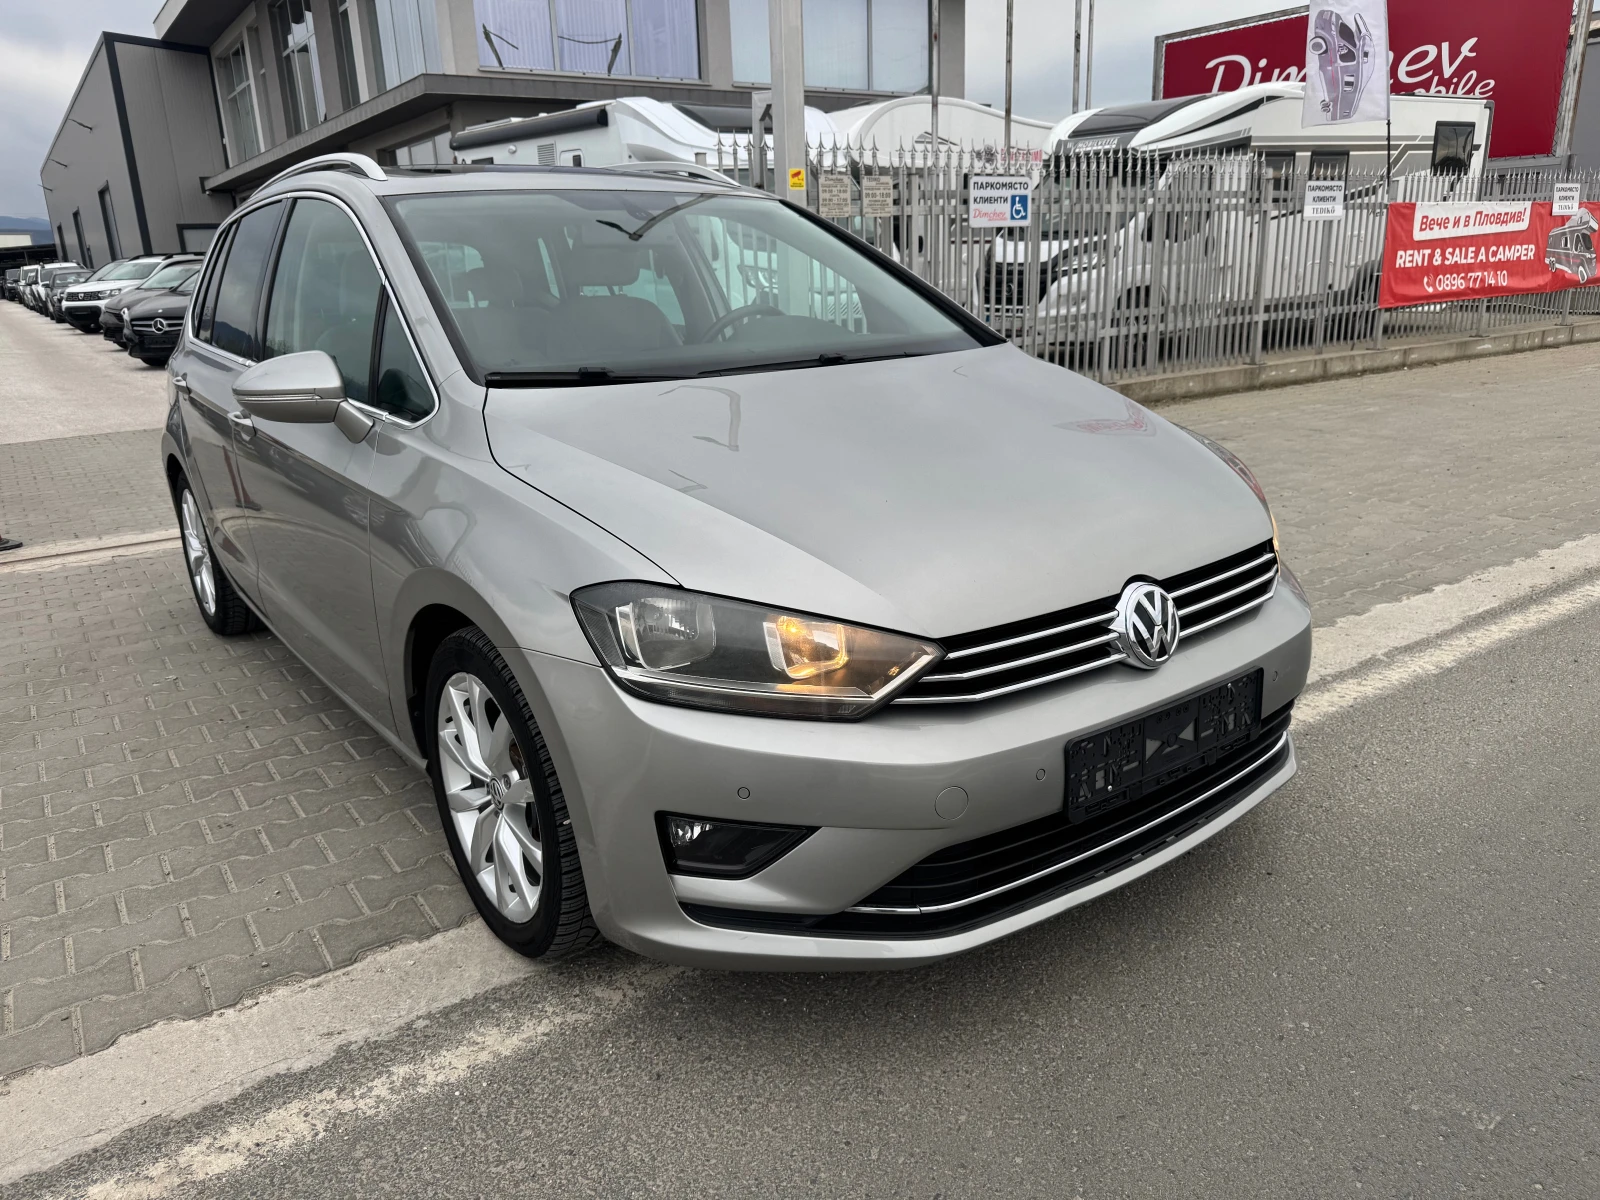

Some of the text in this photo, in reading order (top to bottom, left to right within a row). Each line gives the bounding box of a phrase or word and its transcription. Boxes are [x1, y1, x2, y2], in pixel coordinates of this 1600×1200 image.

[1204, 37, 1478, 93] Dimev
[973, 181, 1029, 191] ПАРКОМЯСТО
[973, 196, 1008, 205] КЛИЕНТИ
[1312, 195, 1337, 203] КЛИЕНТИ
[1419, 207, 1527, 232] Вече и в Пловдив!
[1395, 244, 1536, 268] RENT & SALE A CAMPER
[1435, 270, 1508, 291] 0896 77 14 10
